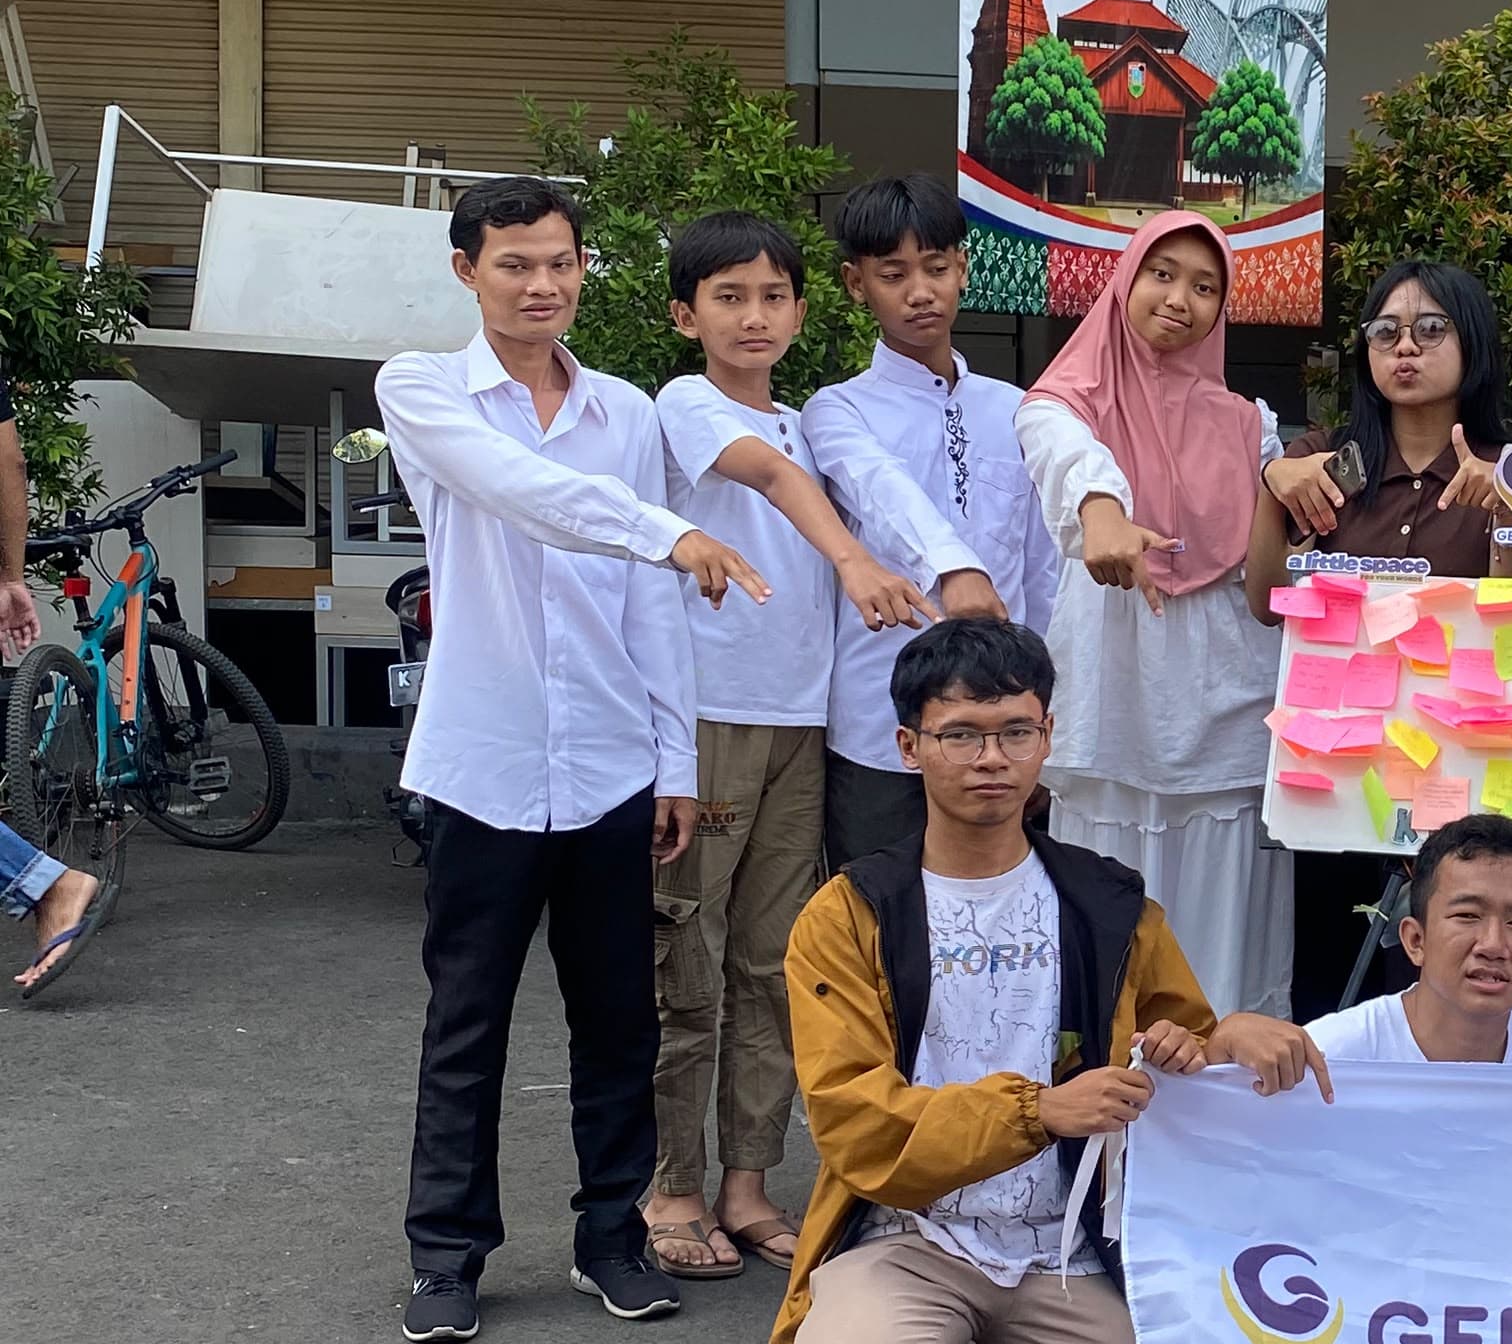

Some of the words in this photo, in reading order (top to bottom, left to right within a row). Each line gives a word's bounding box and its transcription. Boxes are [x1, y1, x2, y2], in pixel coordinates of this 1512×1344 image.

[1288, 557, 1301, 568] a
[1305, 551, 1359, 571] little
[1360, 559, 1429, 573] space
[398, 670, 412, 688] K
[935, 939, 1049, 976] YORK
